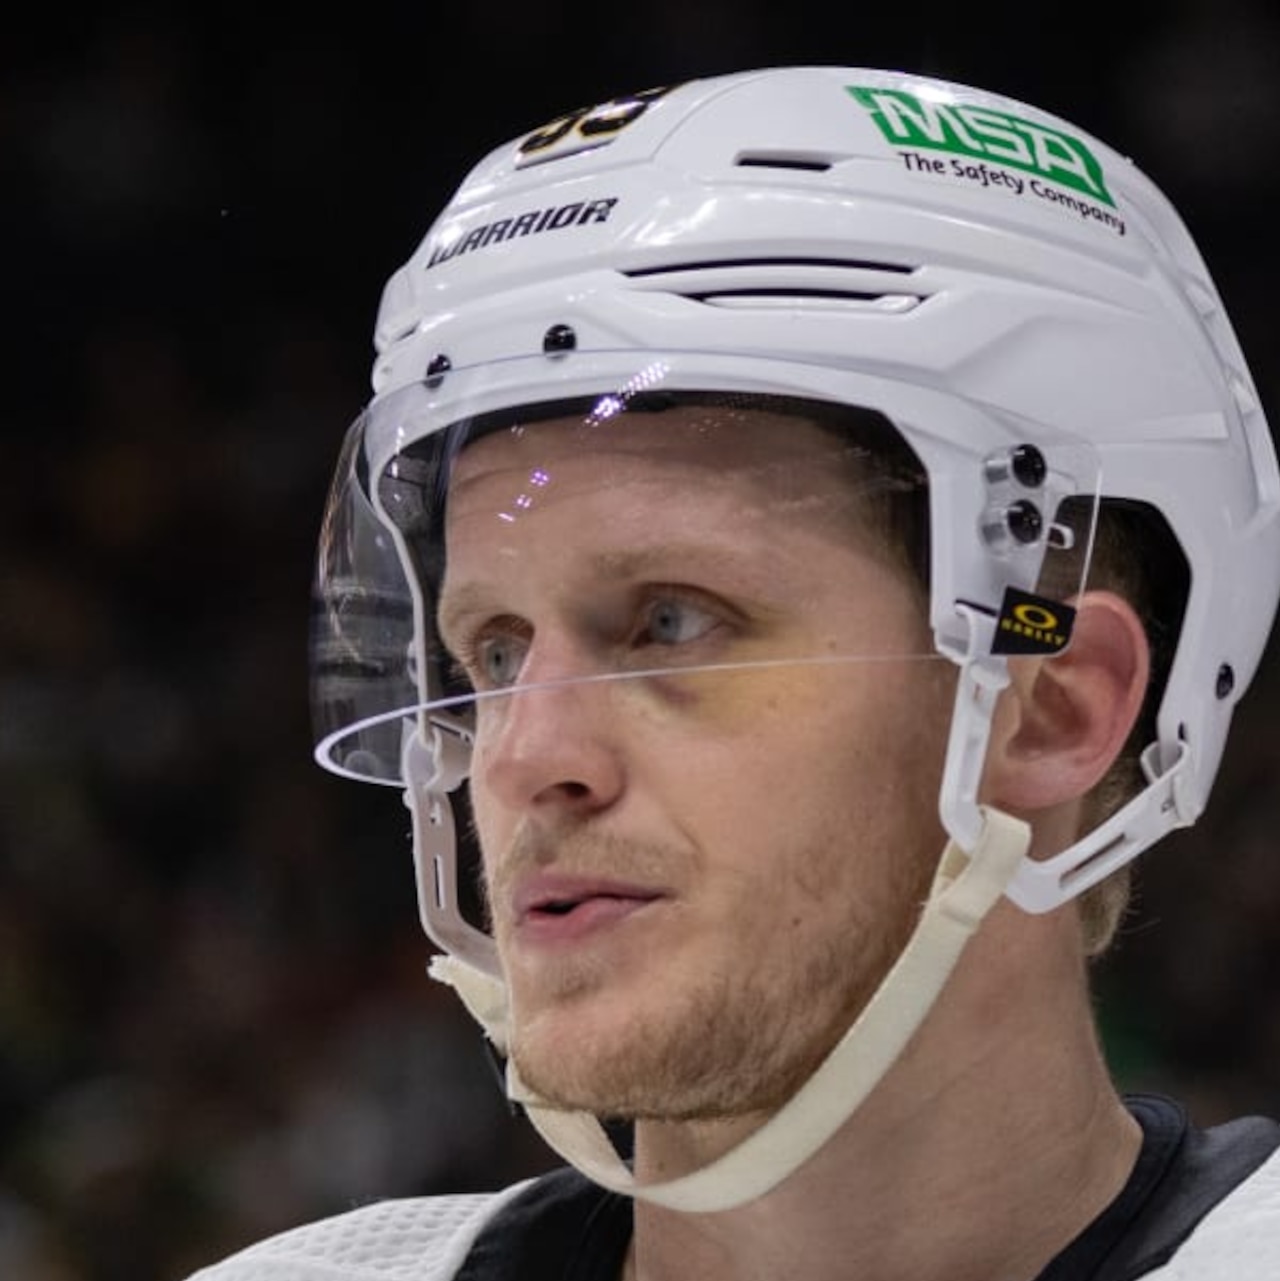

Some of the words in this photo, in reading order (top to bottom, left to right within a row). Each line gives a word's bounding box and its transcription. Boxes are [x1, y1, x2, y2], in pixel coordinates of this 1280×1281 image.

[862, 89, 1110, 197] MSA
[426, 198, 619, 269] WARRIOR
[899, 152, 946, 174] The
[954, 159, 1025, 194] Safety
[1030, 180, 1126, 236] Company
